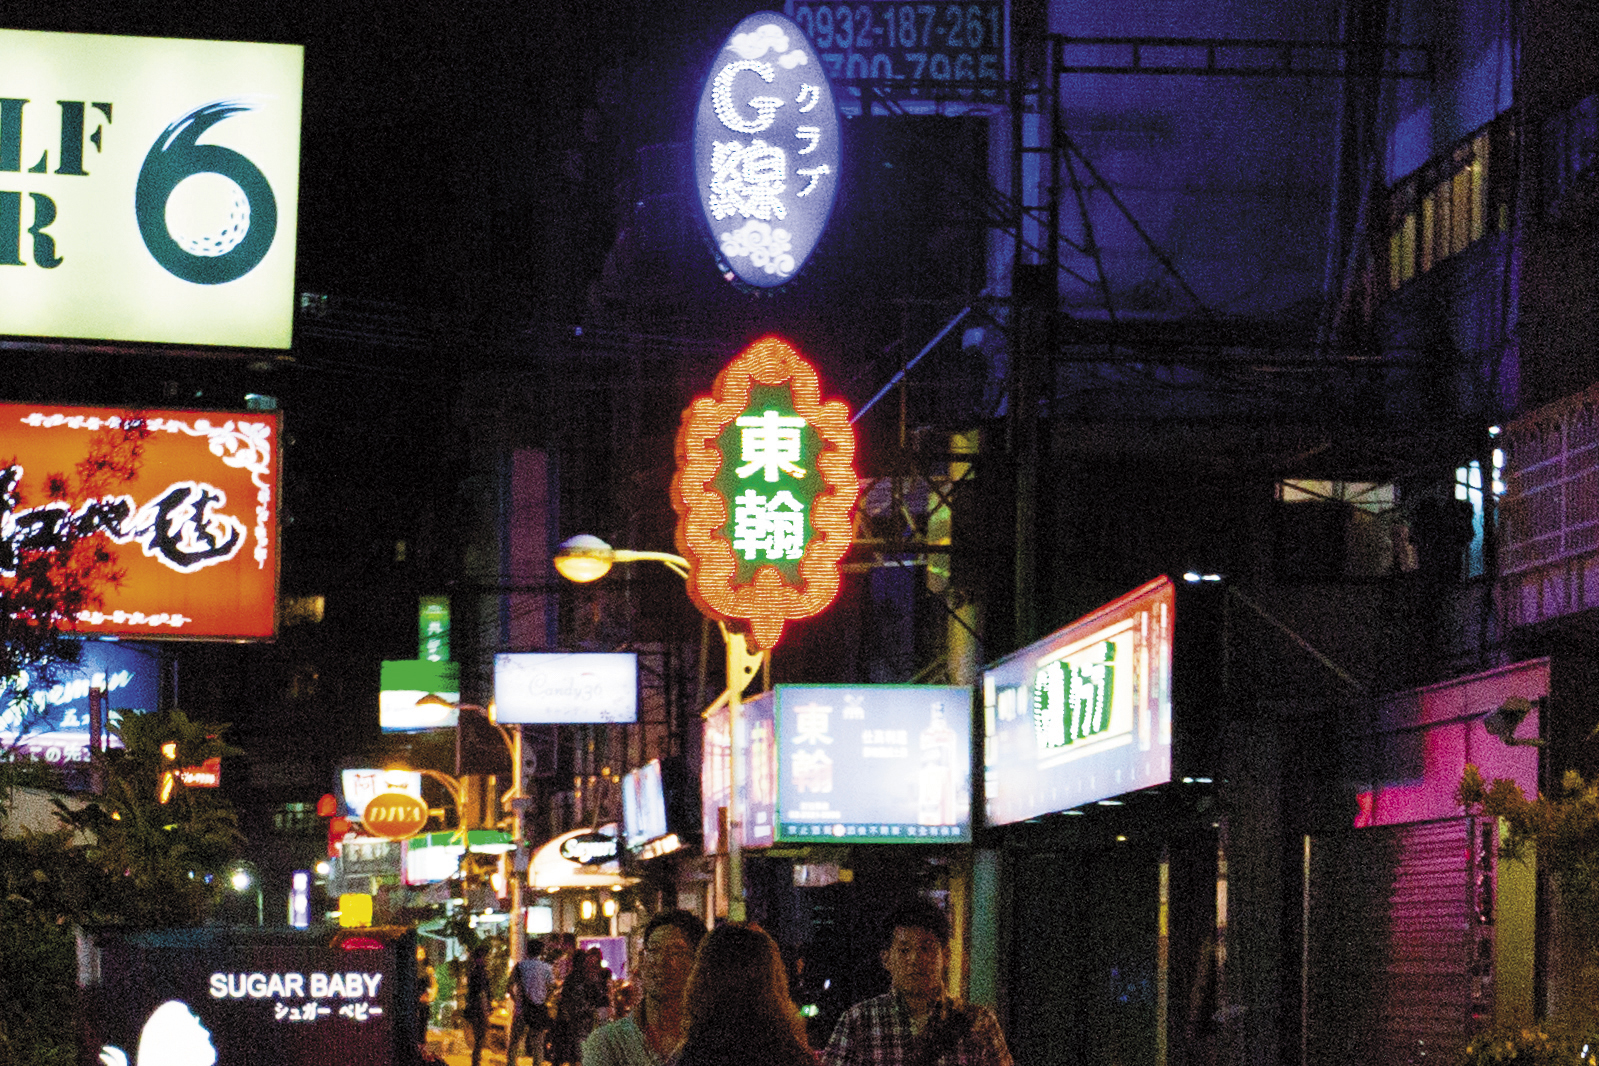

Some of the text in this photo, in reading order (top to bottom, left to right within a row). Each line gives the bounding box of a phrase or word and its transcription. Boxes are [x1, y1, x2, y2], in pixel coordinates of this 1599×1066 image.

[134, 94, 279, 286] 6
[209, 972, 383, 998] SUGAR BABY
[274, 1001, 383, 1020] シュガー ベビー
